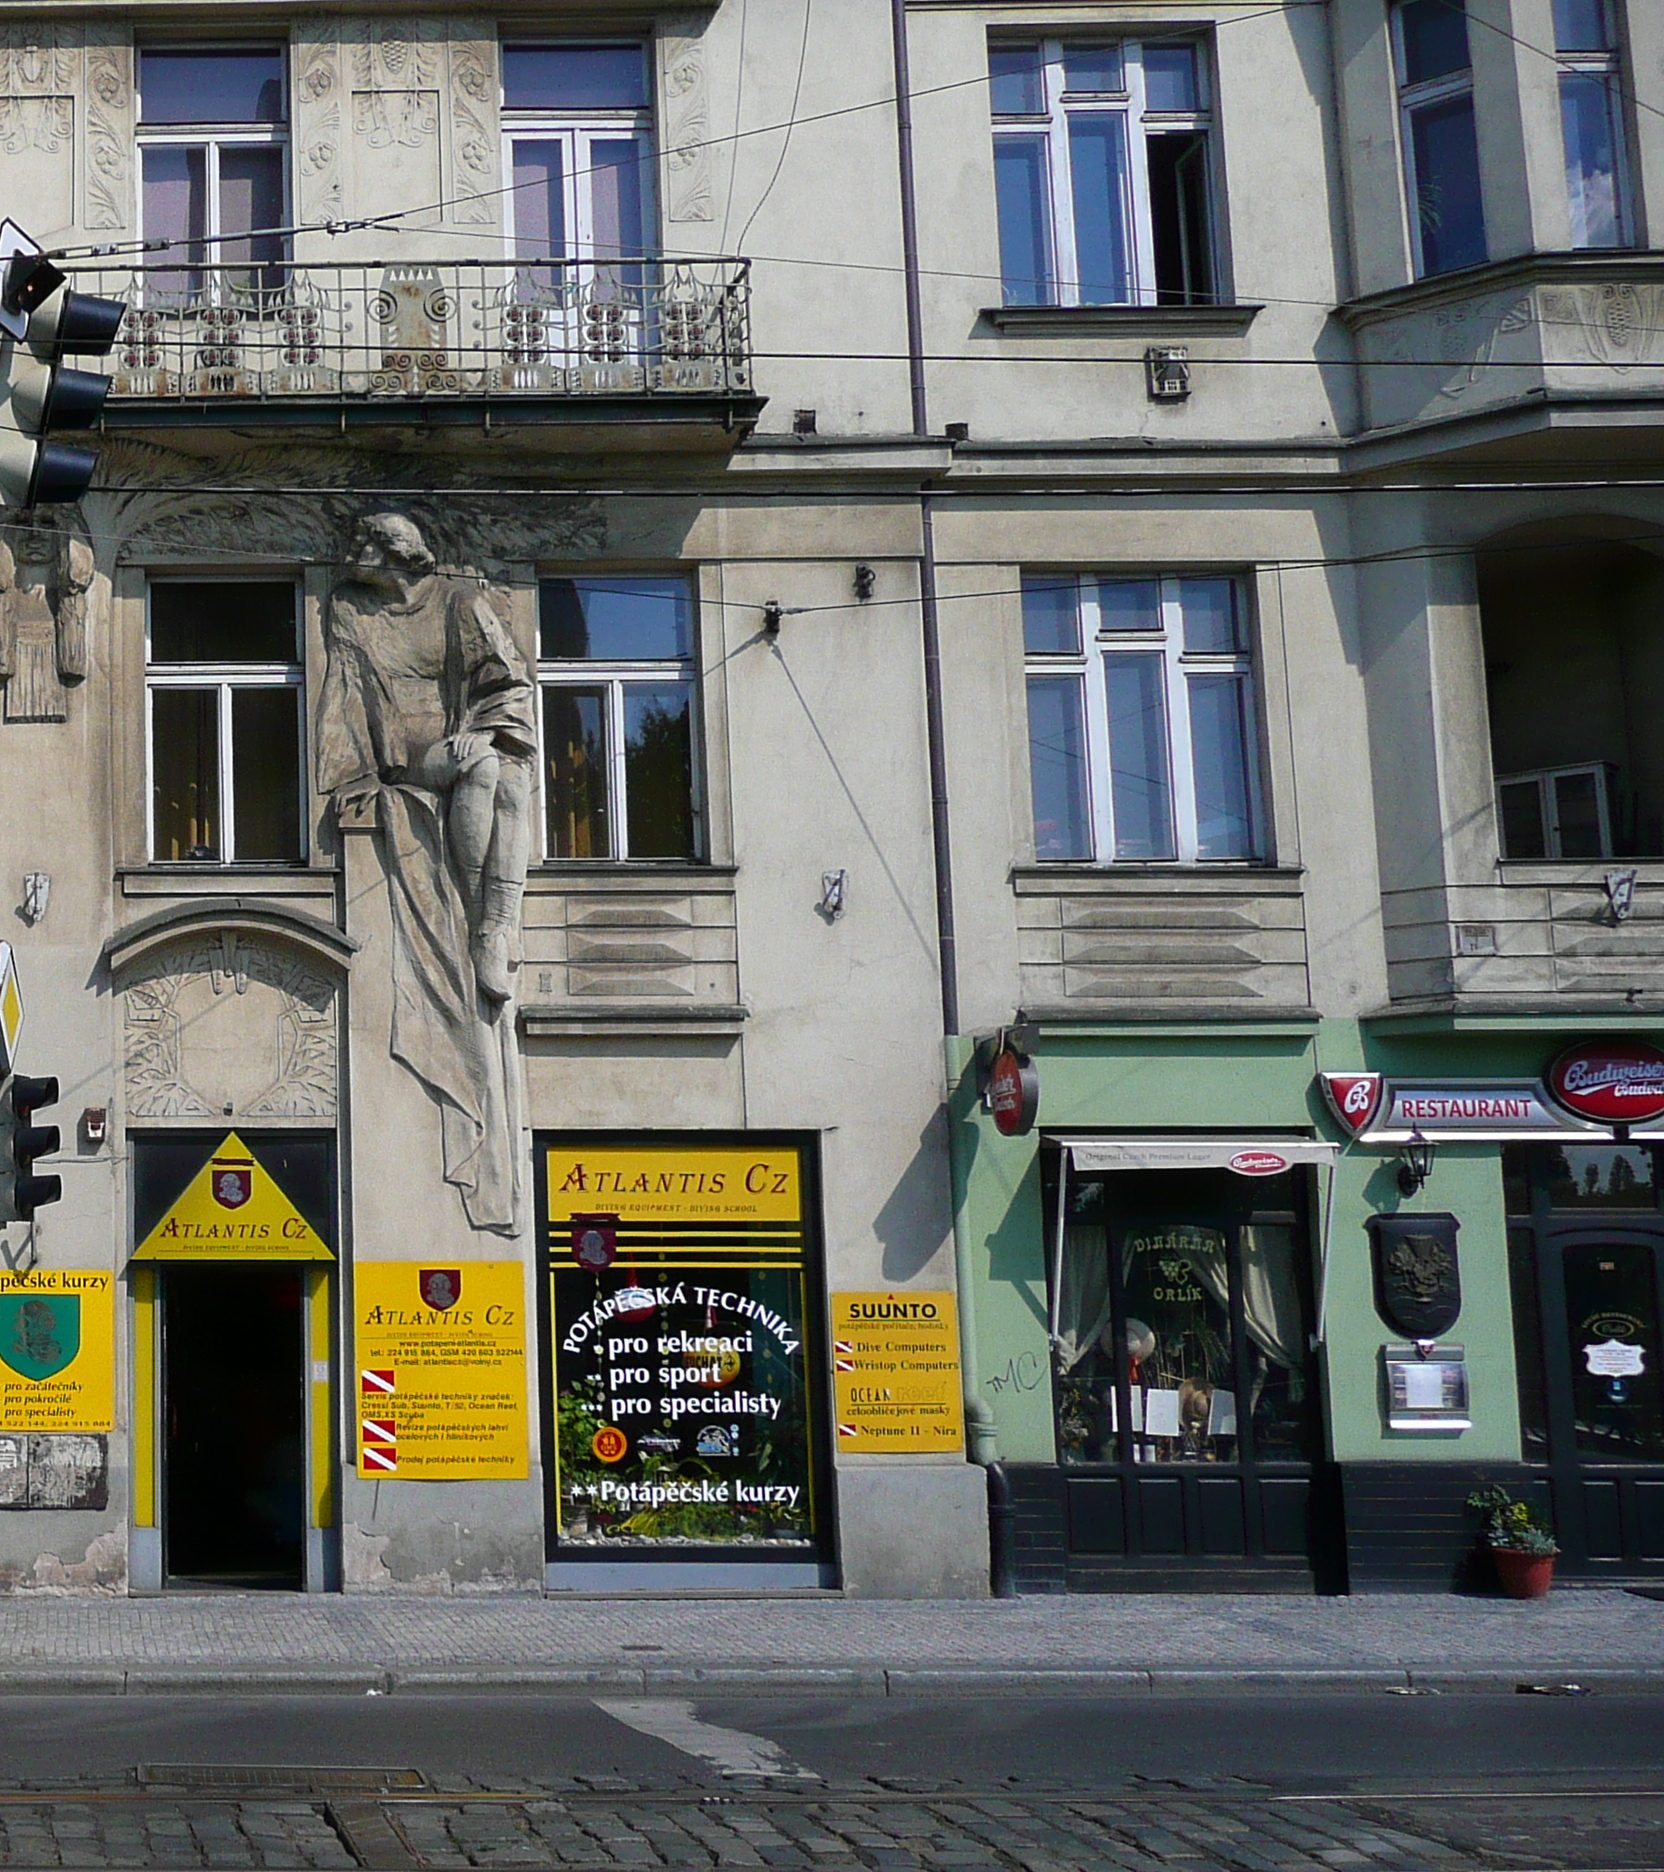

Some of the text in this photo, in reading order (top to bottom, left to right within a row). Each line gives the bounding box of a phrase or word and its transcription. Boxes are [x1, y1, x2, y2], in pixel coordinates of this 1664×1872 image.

[1402, 1099, 1532, 1119] RESTAURANT
[1085, 1152, 1121, 1162] Original
[559, 1163, 727, 1194] ATLANTIS
[595, 1203, 626, 1211] DIVING
[629, 1203, 681, 1212] EQUIPMENT
[724, 1205, 757, 1213] SCHOOL
[159, 1217, 270, 1239] ATLANTIS
[62, 1272, 108, 1292] kurzy
[1153, 1284, 1202, 1301] ORLÍK
[364, 1305, 474, 1325] ATLANTIS
[563, 1281, 801, 1355] POTÁPĚČSKÁ TECHNIKA
[849, 1303, 937, 1319] SUUNTO
[440, 1349, 459, 1357] GSM
[608, 1330, 754, 1361] pro rekreaci
[857, 1342, 946, 1354] Dive Computers
[854, 1360, 959, 1372] Wristop Computers
[610, 1363, 722, 1391] pro sport
[4, 1384, 22, 1394] pro
[850, 1387, 891, 1402] OCEAN
[4, 1393, 72, 1406] pro pokročilé
[611, 1391, 782, 1421] pro specialisty
[4, 1407, 77, 1420] pro specialisty
[919, 1405, 951, 1416] masky
[861, 1425, 906, 1437] Neptune
[933, 1425, 957, 1436] Nira
[600, 1479, 800, 1508] Potápěčské kurzy
